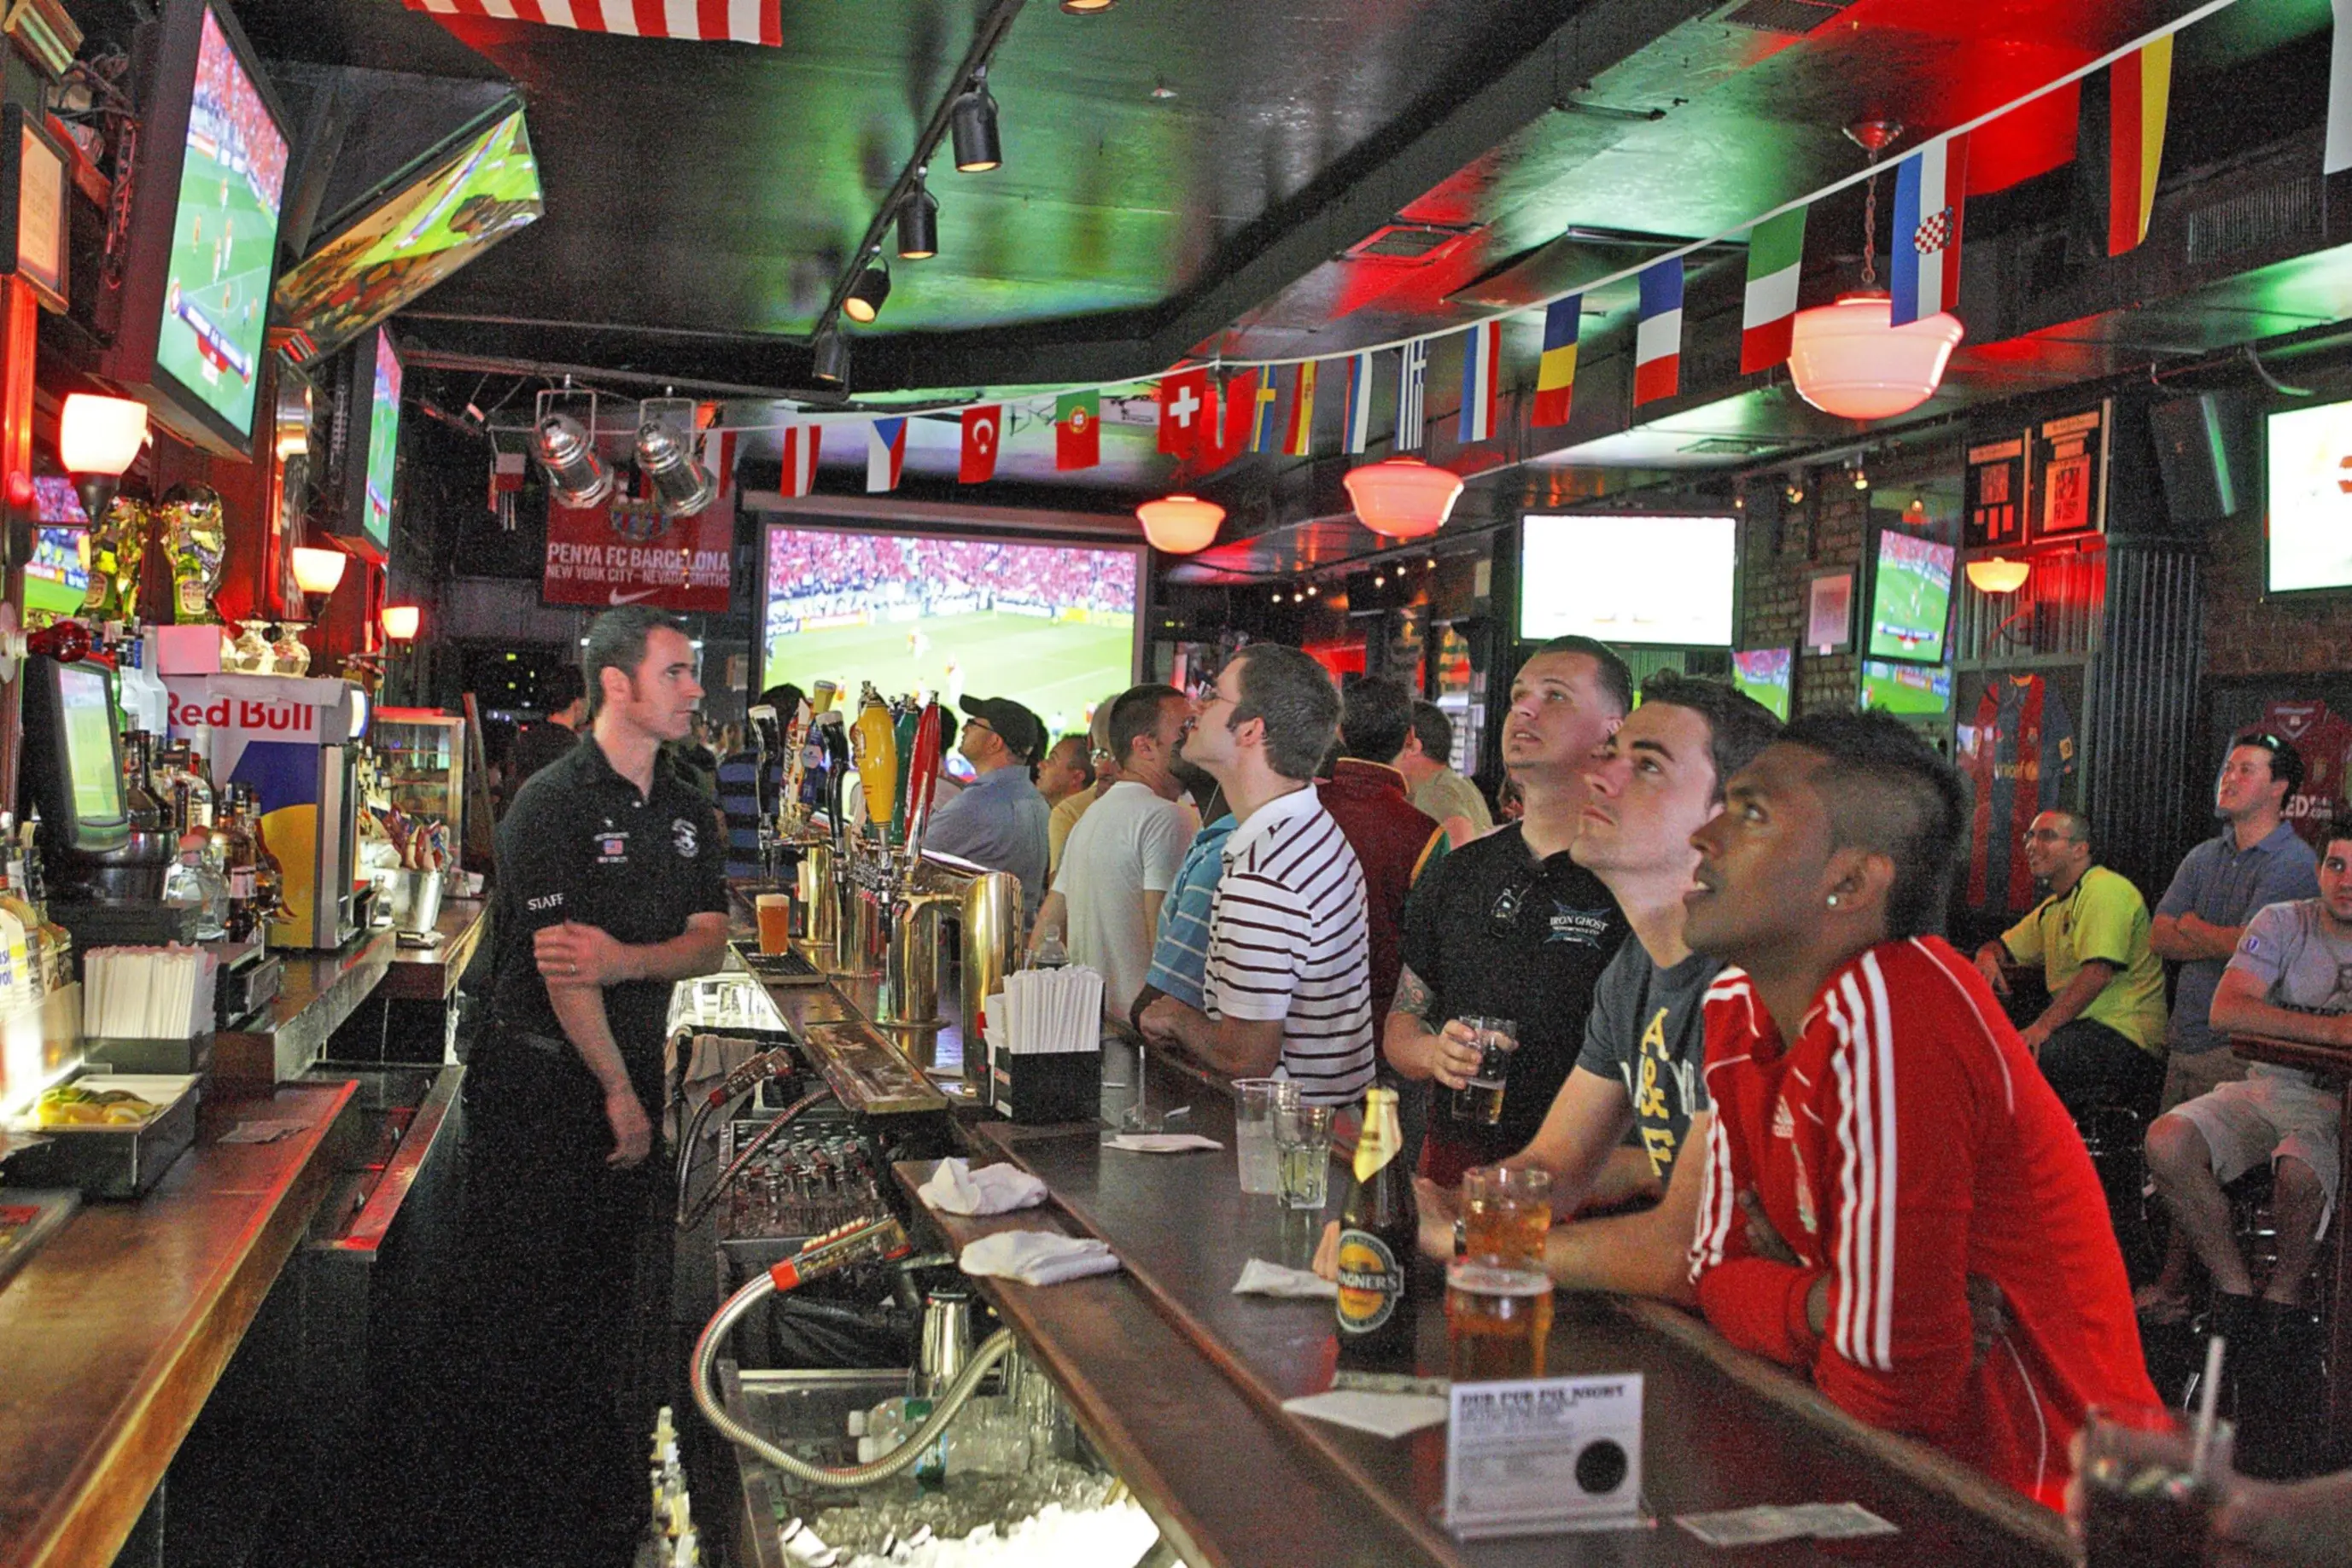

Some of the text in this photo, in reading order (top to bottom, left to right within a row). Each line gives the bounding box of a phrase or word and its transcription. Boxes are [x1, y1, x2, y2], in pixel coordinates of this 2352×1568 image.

[548, 542, 732, 572] PENYA FC BARCELONA
[547, 564, 573, 579] NEW
[576, 565, 605, 581] YORK
[688, 572, 731, 587] SMITHS
[167, 691, 312, 732] Red Bull
[527, 893, 564, 911] STAFF
[1550, 915, 1573, 926] IRON
[1575, 916, 1608, 932] GHOST
